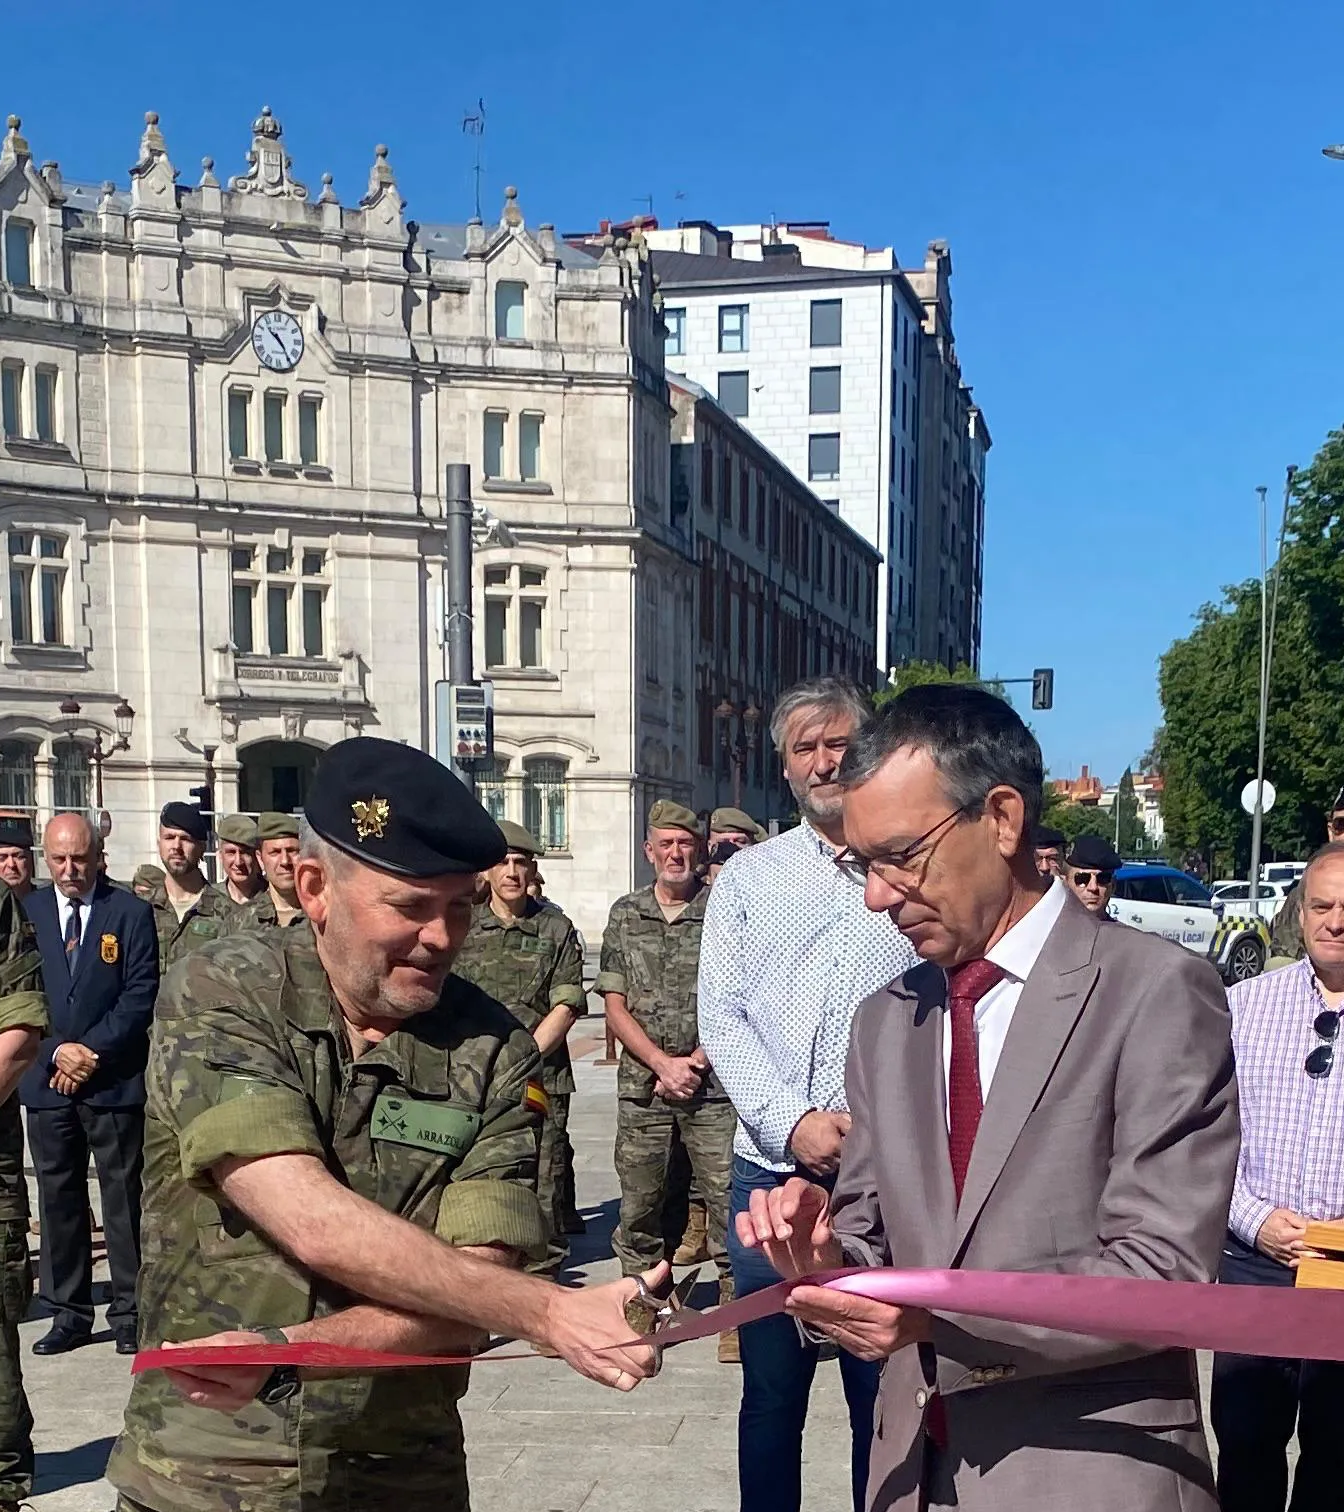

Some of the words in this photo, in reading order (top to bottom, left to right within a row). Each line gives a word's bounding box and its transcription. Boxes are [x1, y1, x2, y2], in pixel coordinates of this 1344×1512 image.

[238, 668, 274, 680] CORREOS
[286, 670, 339, 683] TELEGRAFOS
[1182, 930, 1206, 943] Local
